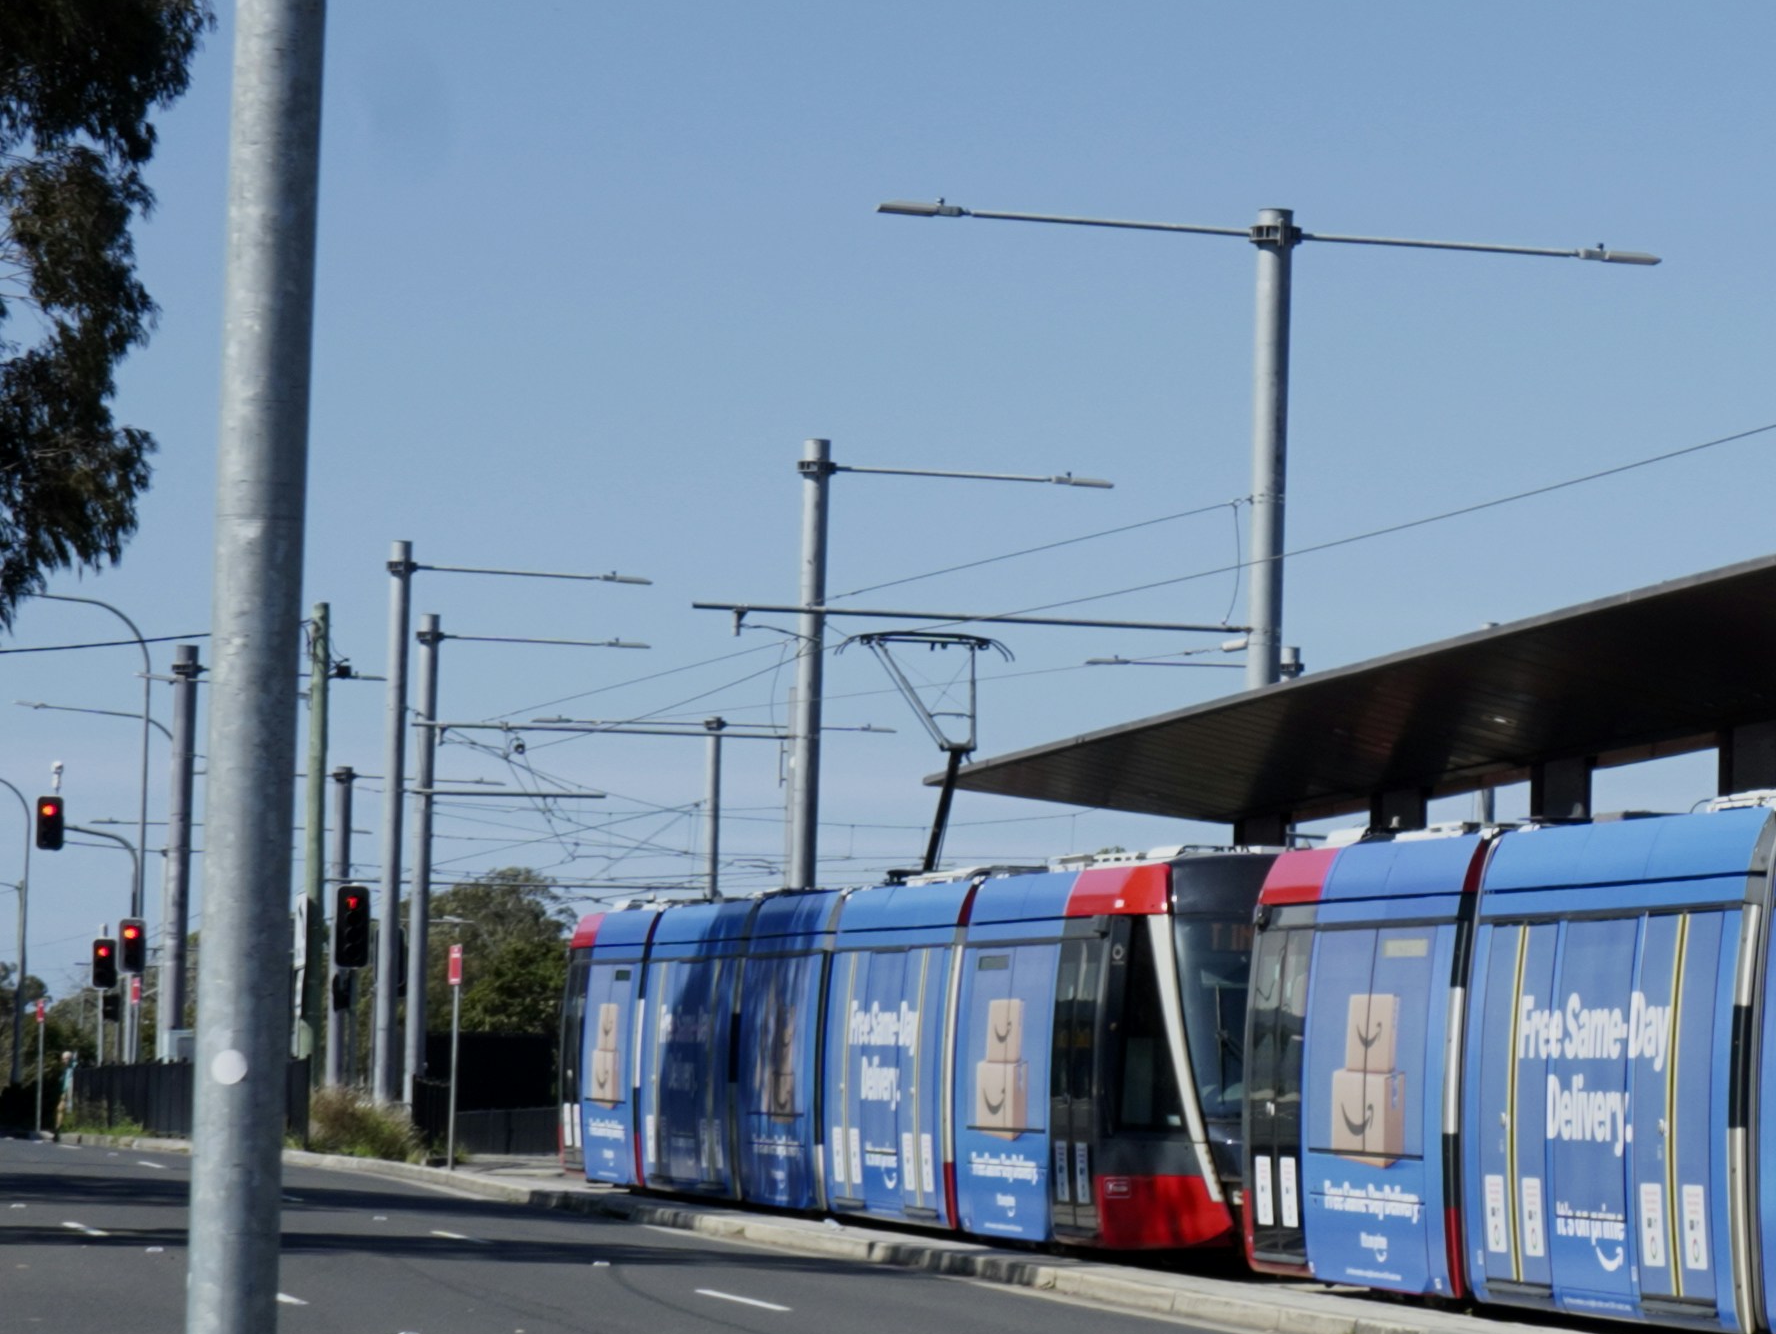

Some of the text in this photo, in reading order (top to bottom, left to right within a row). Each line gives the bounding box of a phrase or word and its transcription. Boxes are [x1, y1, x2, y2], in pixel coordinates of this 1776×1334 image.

[1519, 991, 1671, 1072] Free Same-Day
[1545, 1073, 1633, 1157] Delivery.
